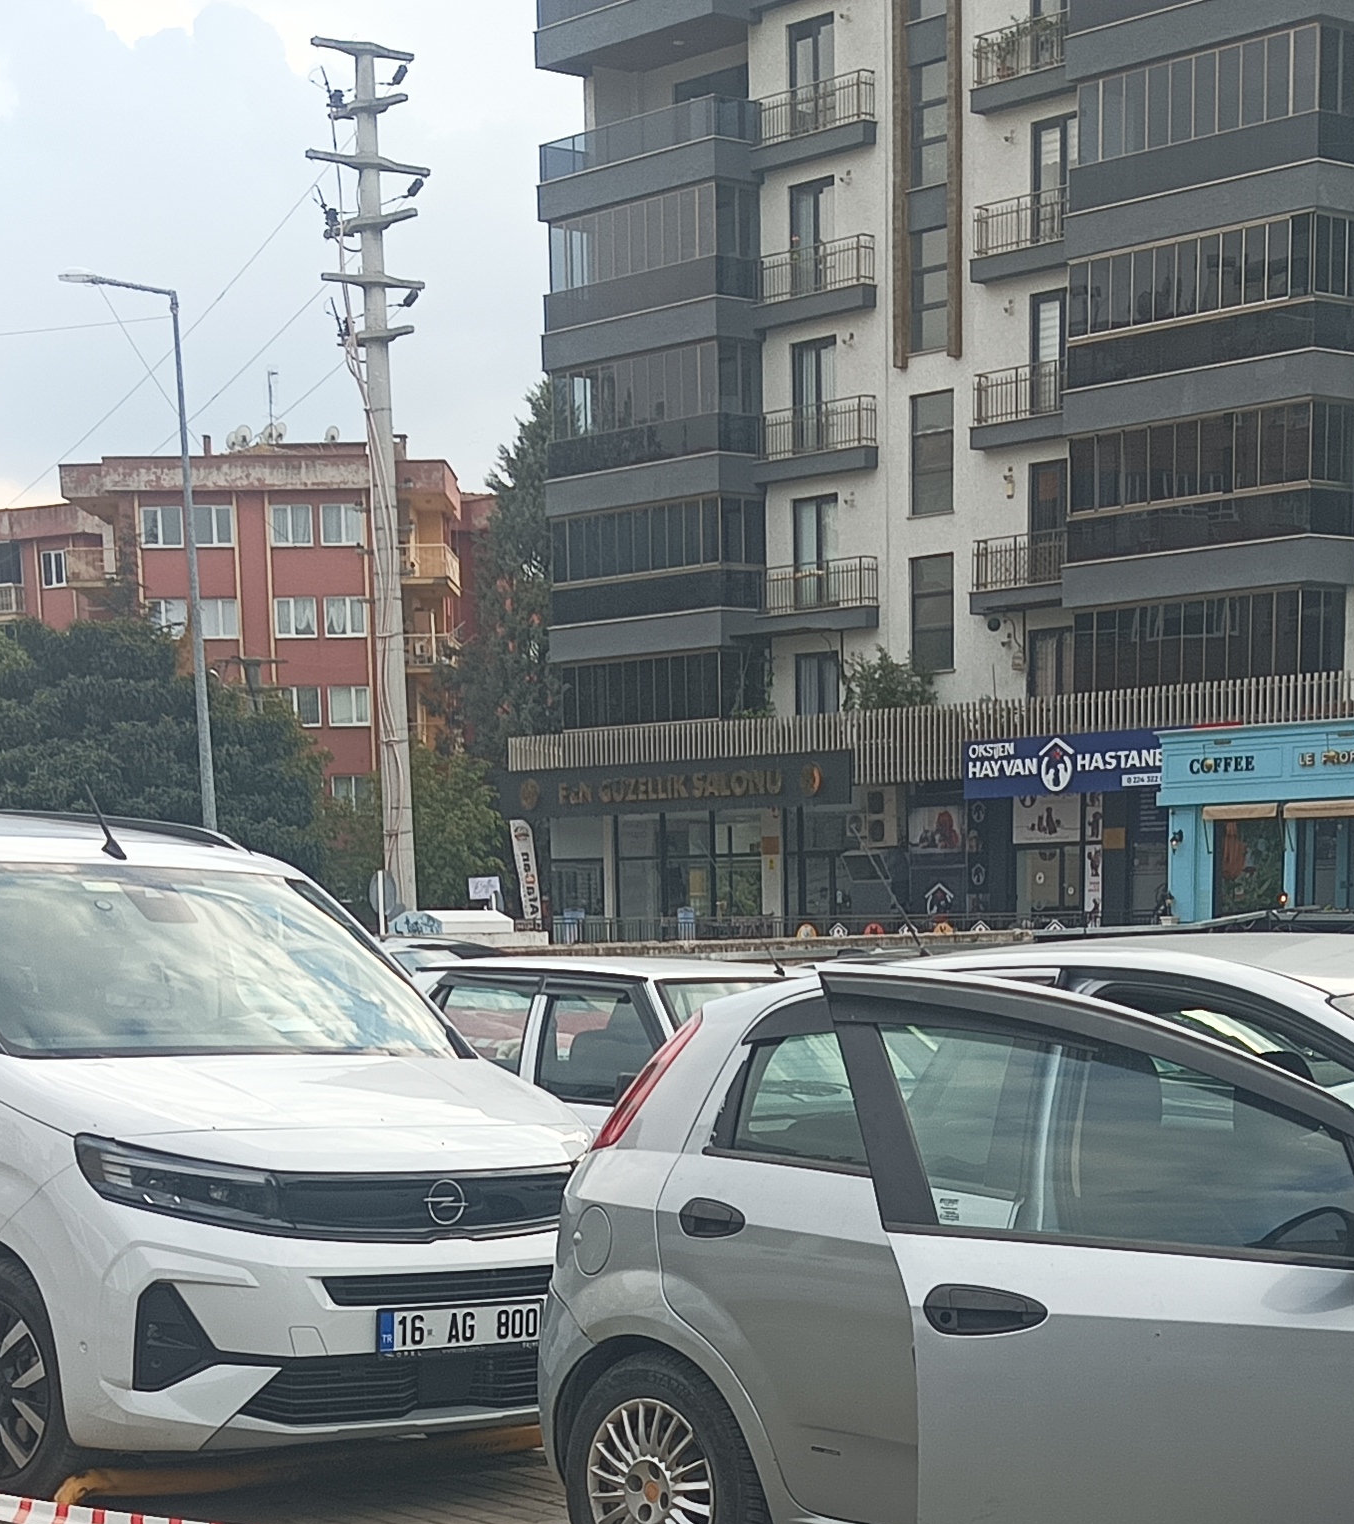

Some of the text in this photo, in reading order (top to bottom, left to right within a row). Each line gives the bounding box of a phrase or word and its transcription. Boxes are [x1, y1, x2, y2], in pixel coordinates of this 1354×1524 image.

[968, 758, 1039, 779] HAYVAN
[1188, 755, 1256, 775] COFFEE
[1299, 751, 1315, 767] LE
[382, 1307, 538, 1347] TR 16 AG 800
